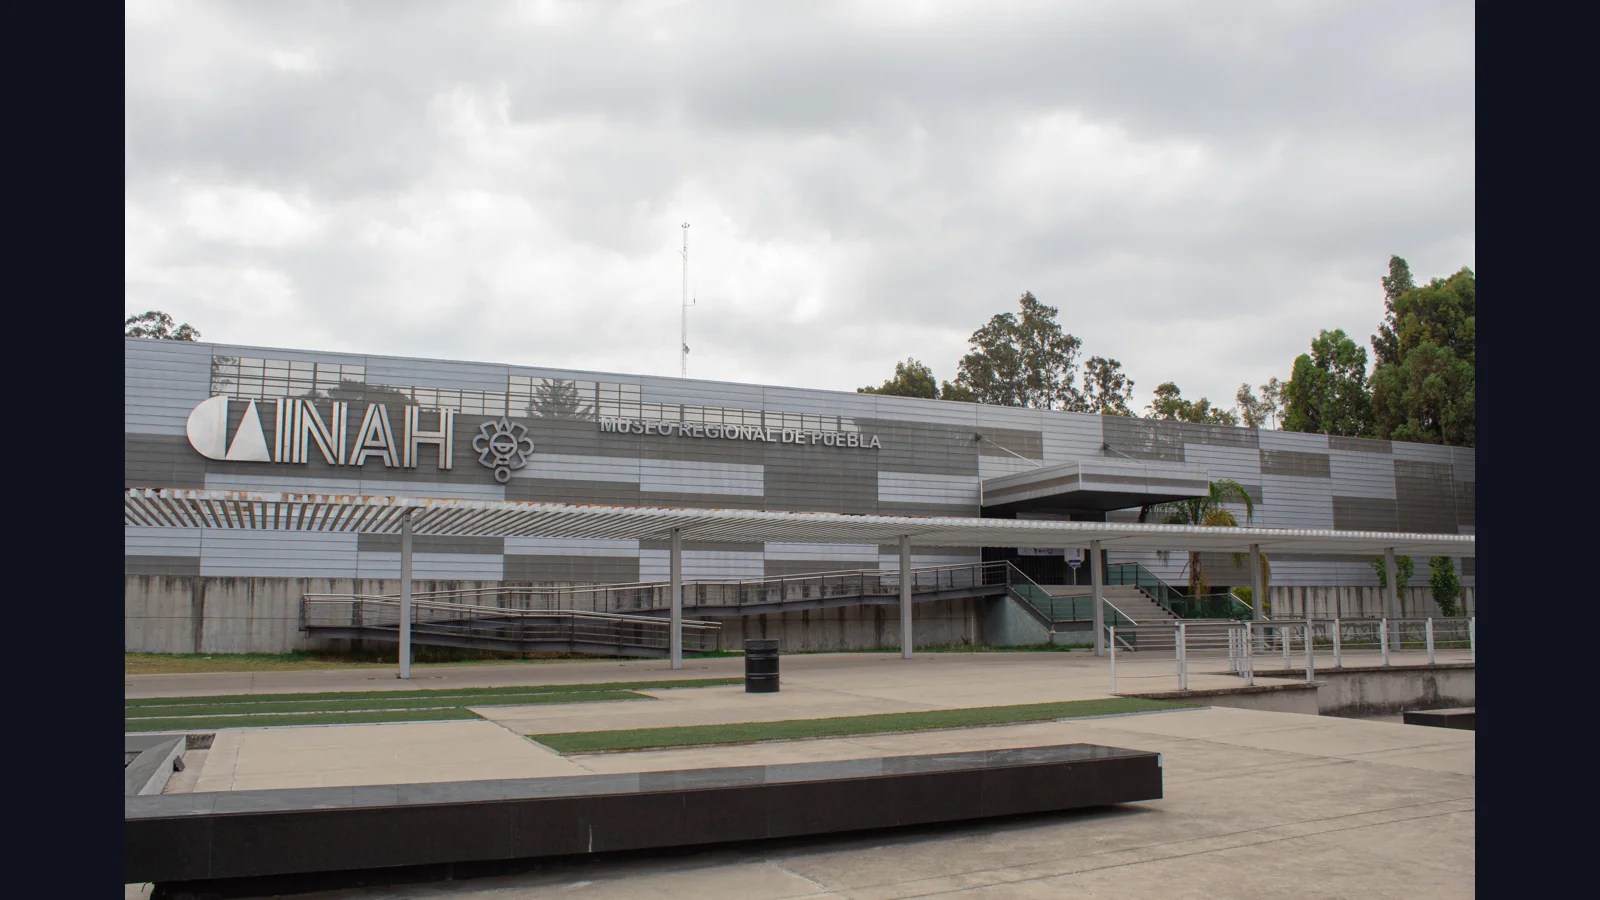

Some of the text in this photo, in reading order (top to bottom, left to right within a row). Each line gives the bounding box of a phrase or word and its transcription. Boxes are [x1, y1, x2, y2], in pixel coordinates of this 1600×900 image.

[274, 398, 455, 470] INAH
[600, 417, 881, 449] MUSEO REGIONAL DE PUEBLA
